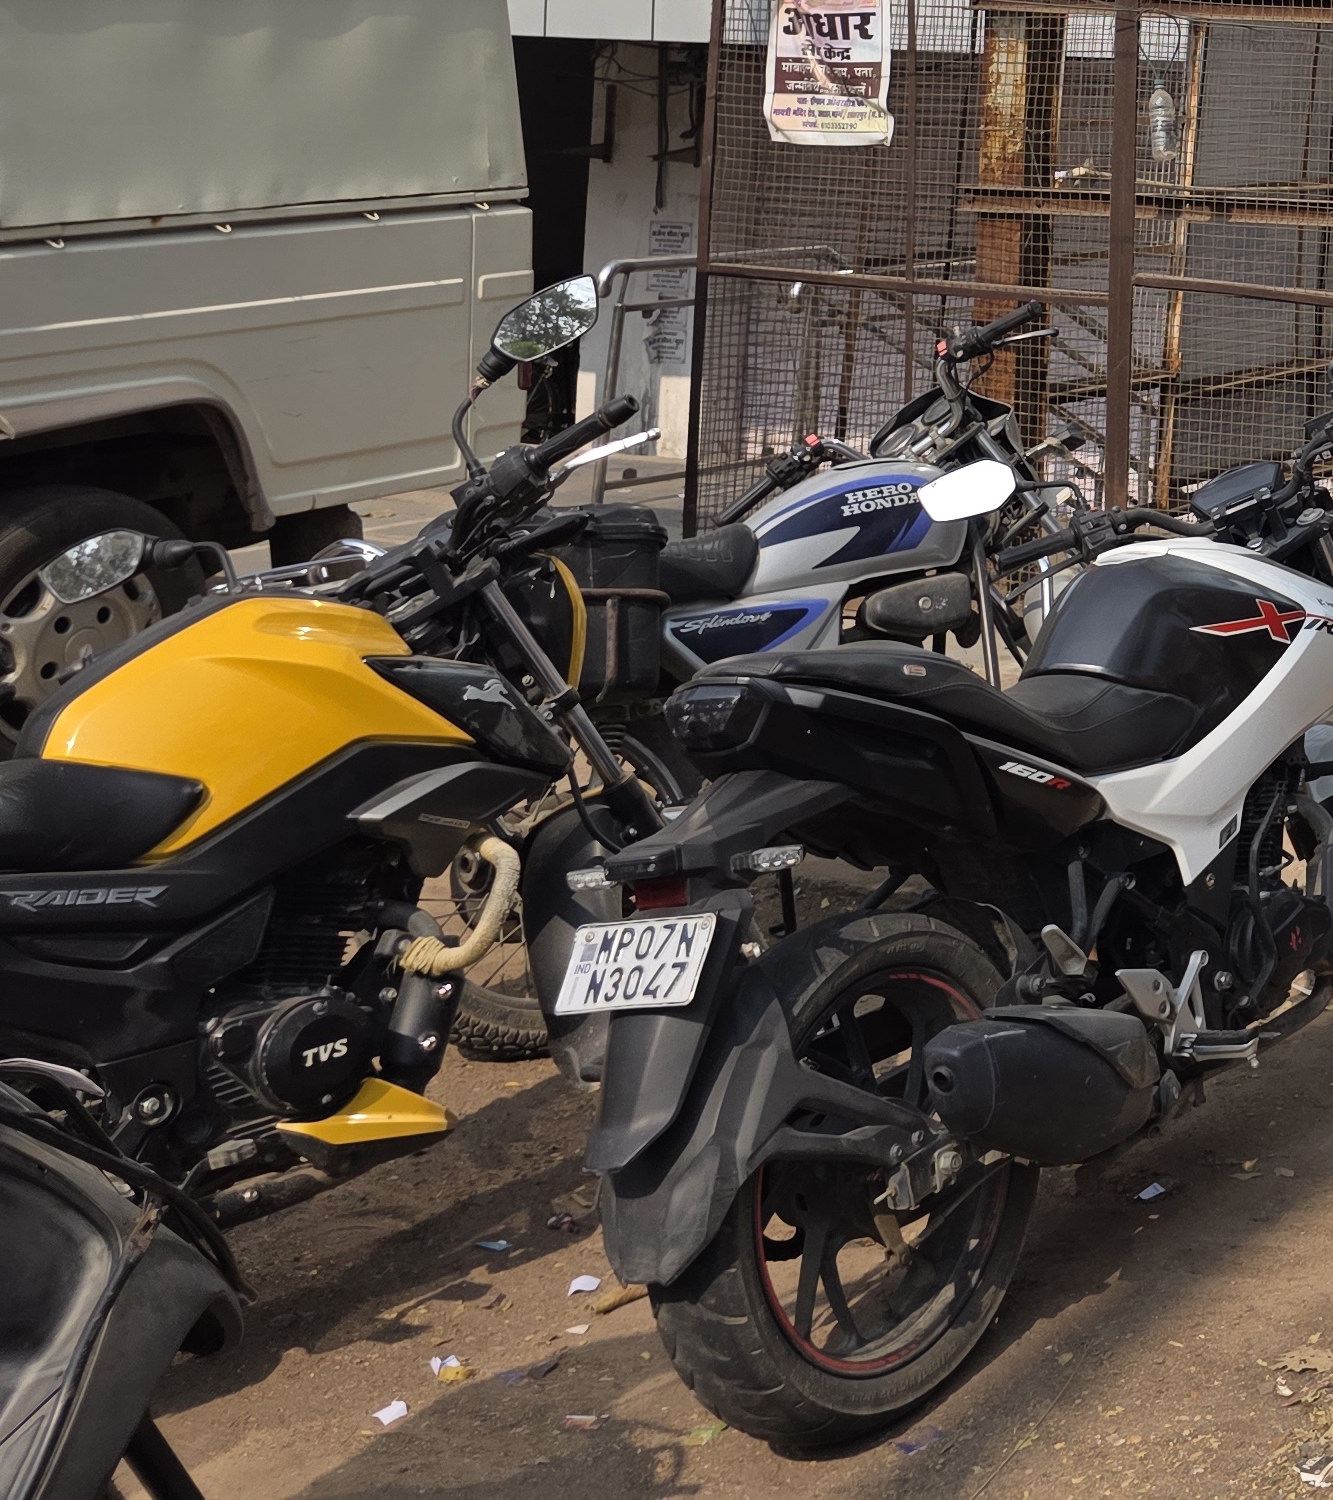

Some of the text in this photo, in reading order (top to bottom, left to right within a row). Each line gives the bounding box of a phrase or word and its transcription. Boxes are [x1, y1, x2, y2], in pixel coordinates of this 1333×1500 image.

[840, 492, 921, 518] HONDA
[844, 481, 913, 503] HERO
[998, 761, 1072, 790] 160R
[0, 885, 171, 913] RAIDER
[595, 921, 698, 965] MP07N
[573, 962, 592, 975] IND
[583, 961, 689, 1005] N3047
[302, 1036, 349, 1068] TVS
